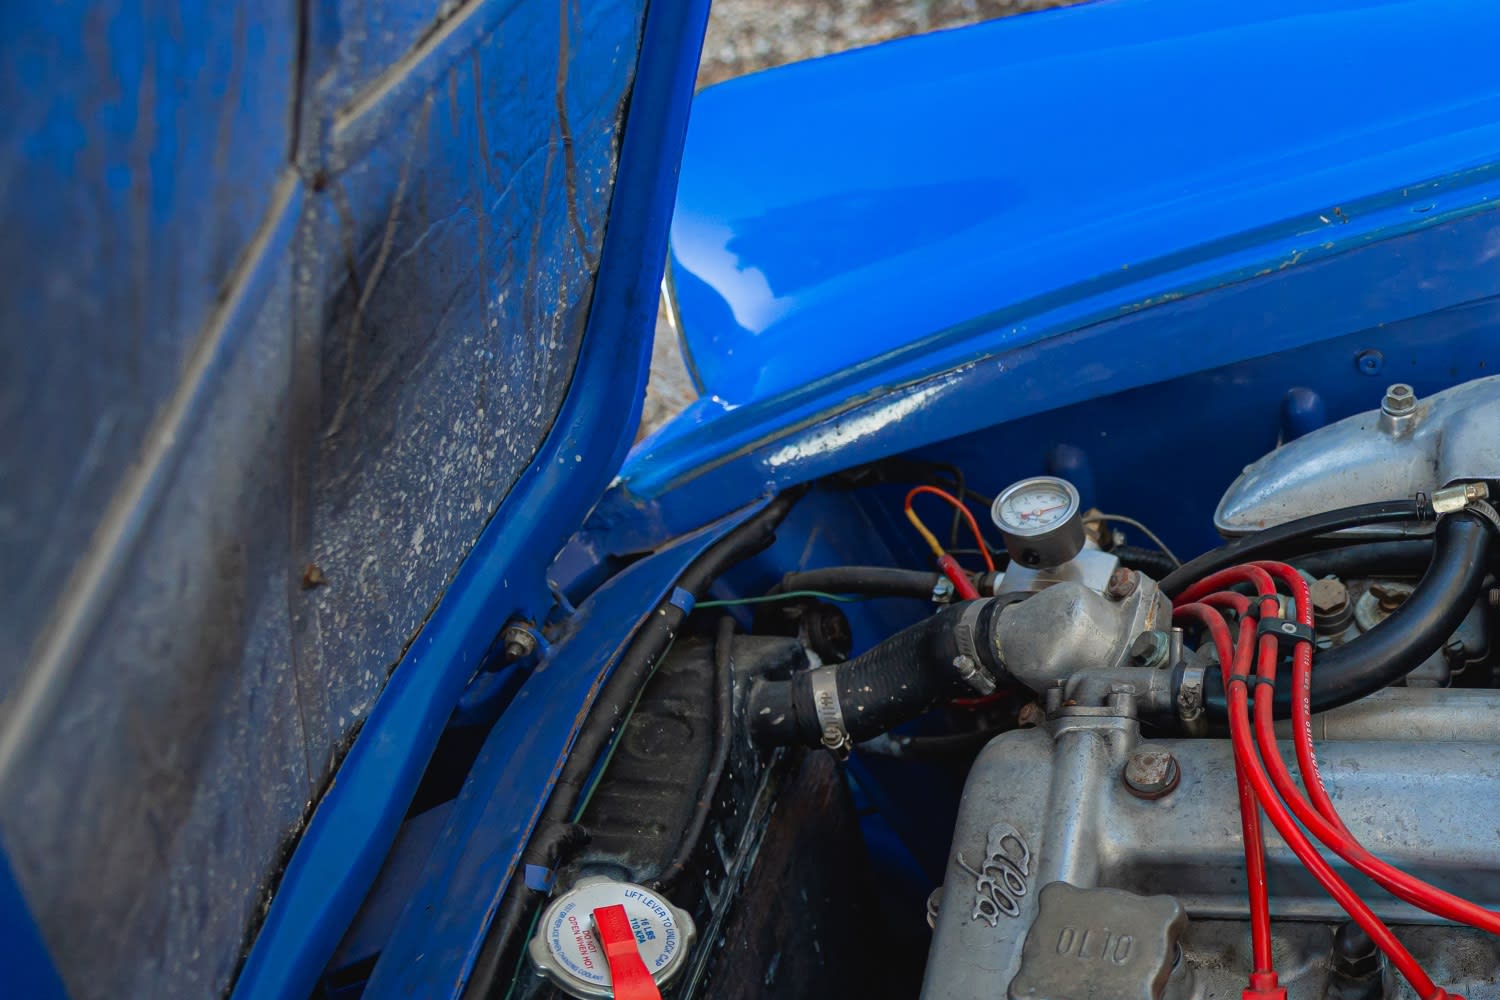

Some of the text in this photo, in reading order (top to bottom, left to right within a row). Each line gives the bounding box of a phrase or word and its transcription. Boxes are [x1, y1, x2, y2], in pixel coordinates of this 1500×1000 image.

[957, 822, 1031, 928] Alfa
[625, 889, 676, 967] LIFT LEVER TO UNLOCK CAP
[635, 930, 646, 944] KPA
[643, 926, 656, 941] LBS
[568, 916, 594, 969] OPEN WHEN HOT
[583, 930, 597, 953] DO NOT
[577, 968, 604, 981] COOLANT
